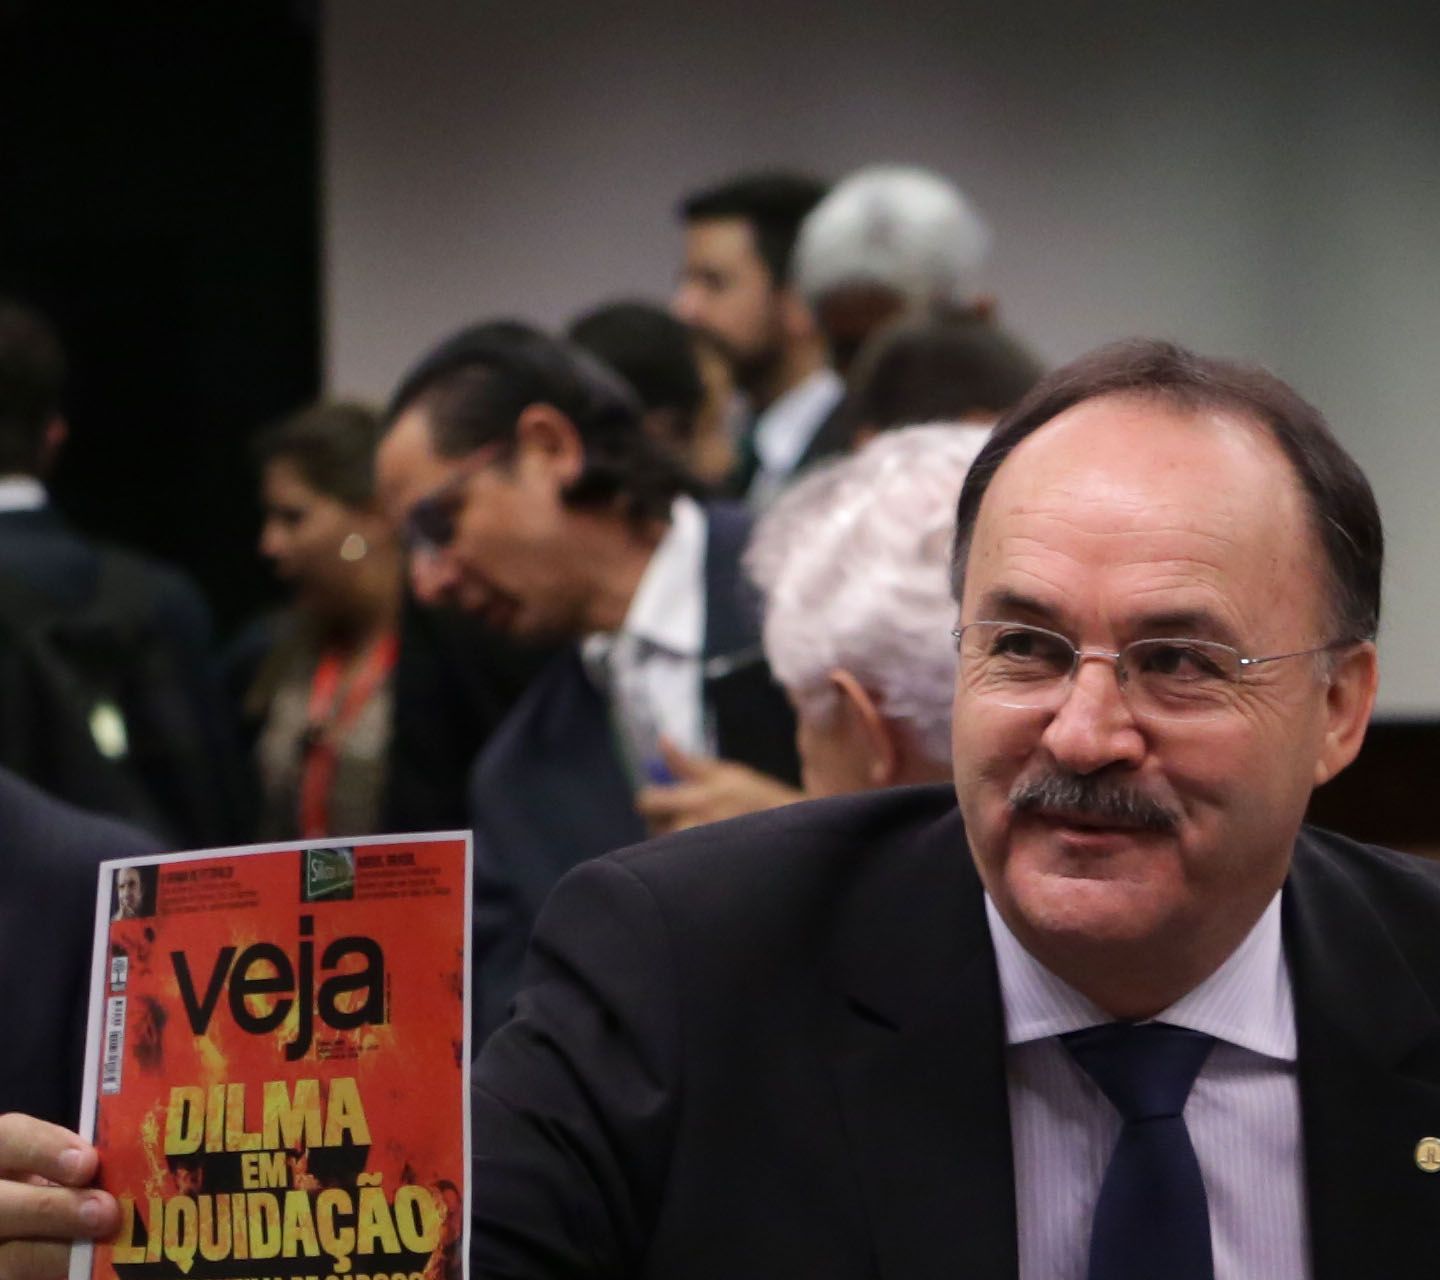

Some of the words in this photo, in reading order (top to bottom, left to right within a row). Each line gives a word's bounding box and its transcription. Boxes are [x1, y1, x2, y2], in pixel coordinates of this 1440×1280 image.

[170, 915, 385, 1061] veja
[164, 1077, 372, 1155] DILMA
[241, 1152, 287, 1189] EM
[112, 1172, 439, 1274] LIQUIDAÇÃO
